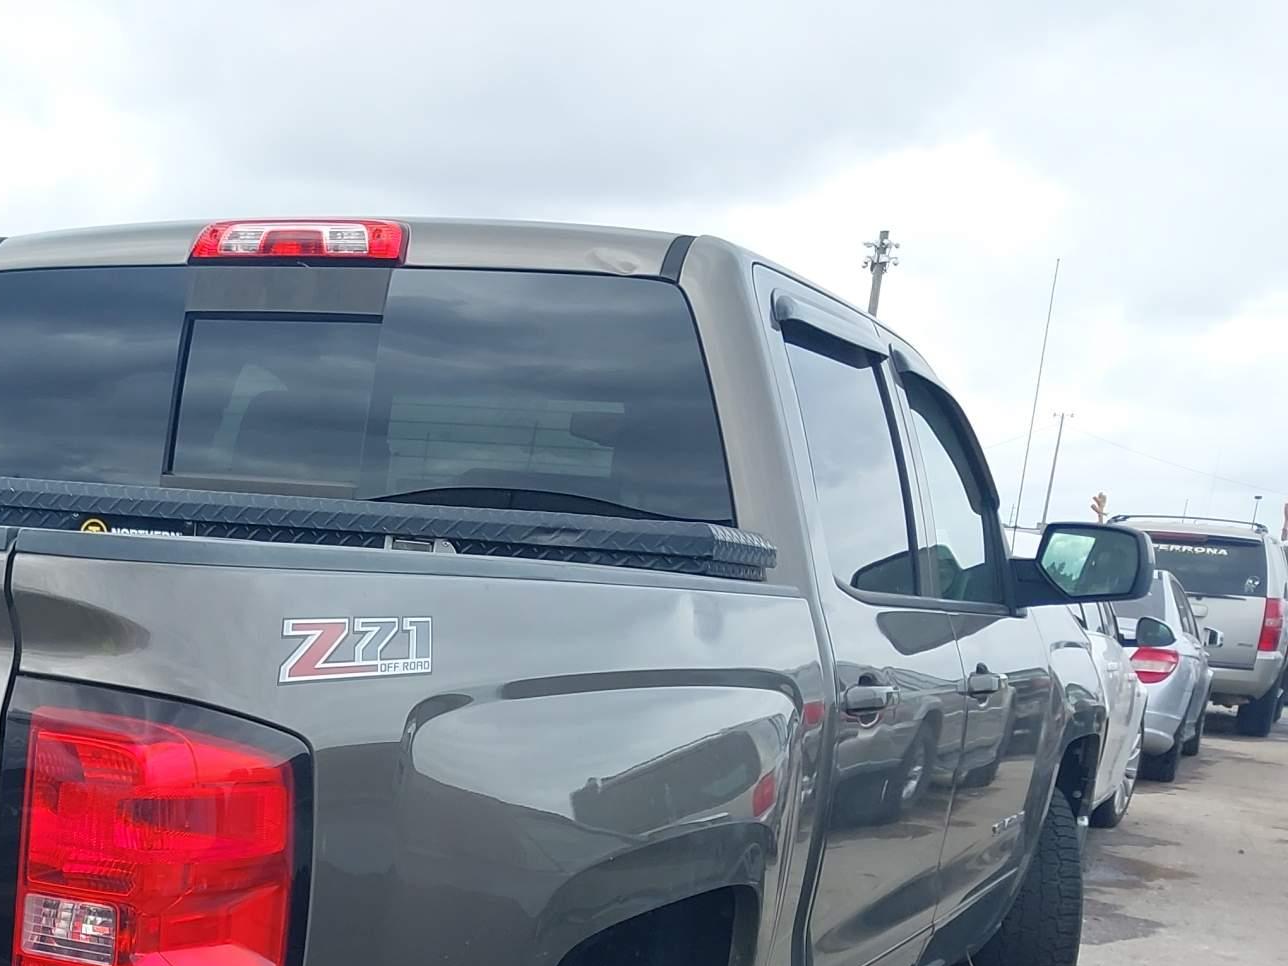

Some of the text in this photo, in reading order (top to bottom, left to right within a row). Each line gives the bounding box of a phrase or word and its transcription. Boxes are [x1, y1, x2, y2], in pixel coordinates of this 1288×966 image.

[277, 617, 432, 685] Z71
[379, 660, 430, 673] OFF ROAD
